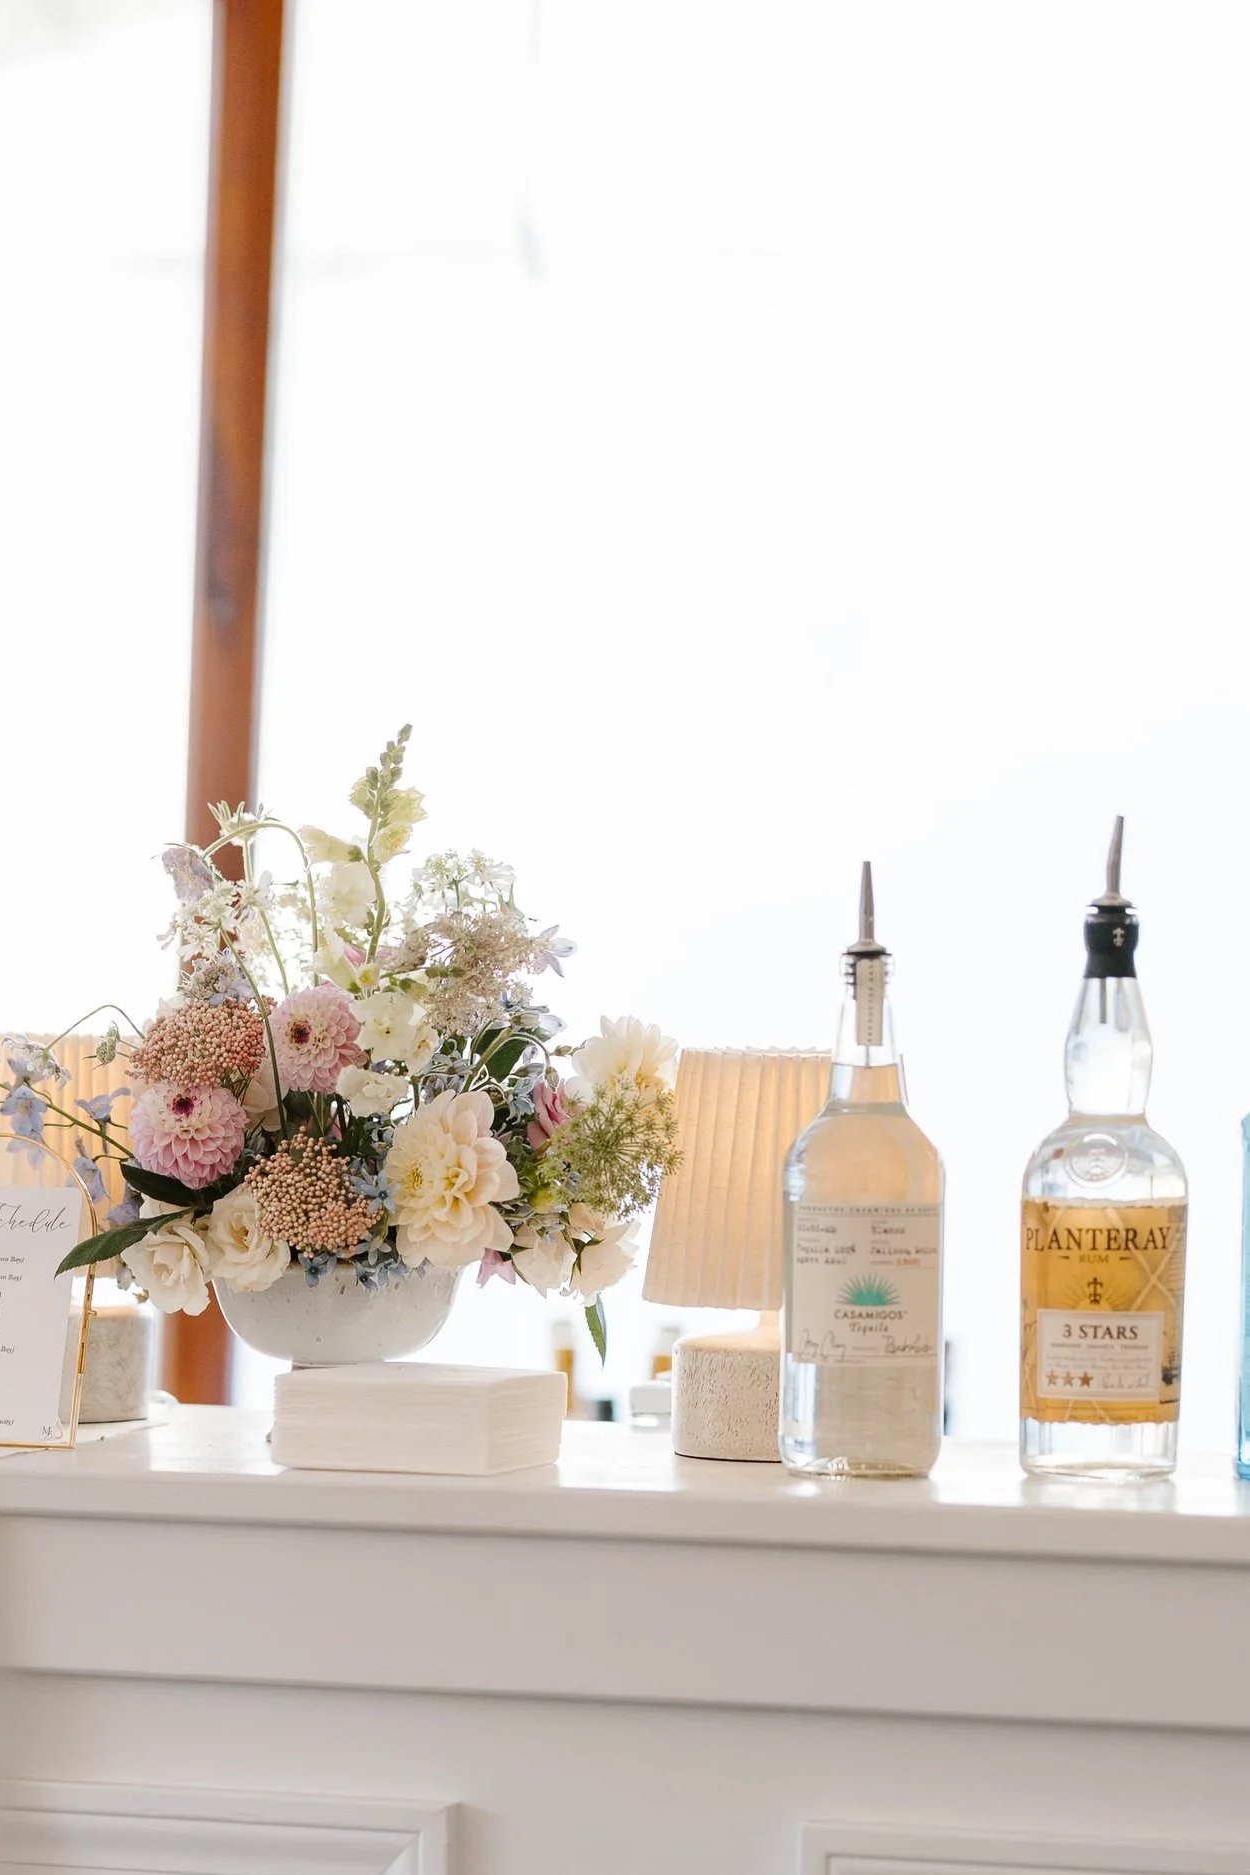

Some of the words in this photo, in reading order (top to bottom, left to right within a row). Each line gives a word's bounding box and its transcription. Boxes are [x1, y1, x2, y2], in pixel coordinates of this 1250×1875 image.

[1026, 1226, 1171, 1252] PLANTERAY
[10, 1256, 24, 1264] Bay)
[1079, 1254, 1109, 1264] RUM
[8, 1274, 23, 1282] Bay)
[834, 1310, 903, 1320] CASAMIGOS
[1063, 1324, 1072, 1337] 3
[1079, 1324, 1138, 1340] STARS
[1, 1345, 15, 1353] Bay)
